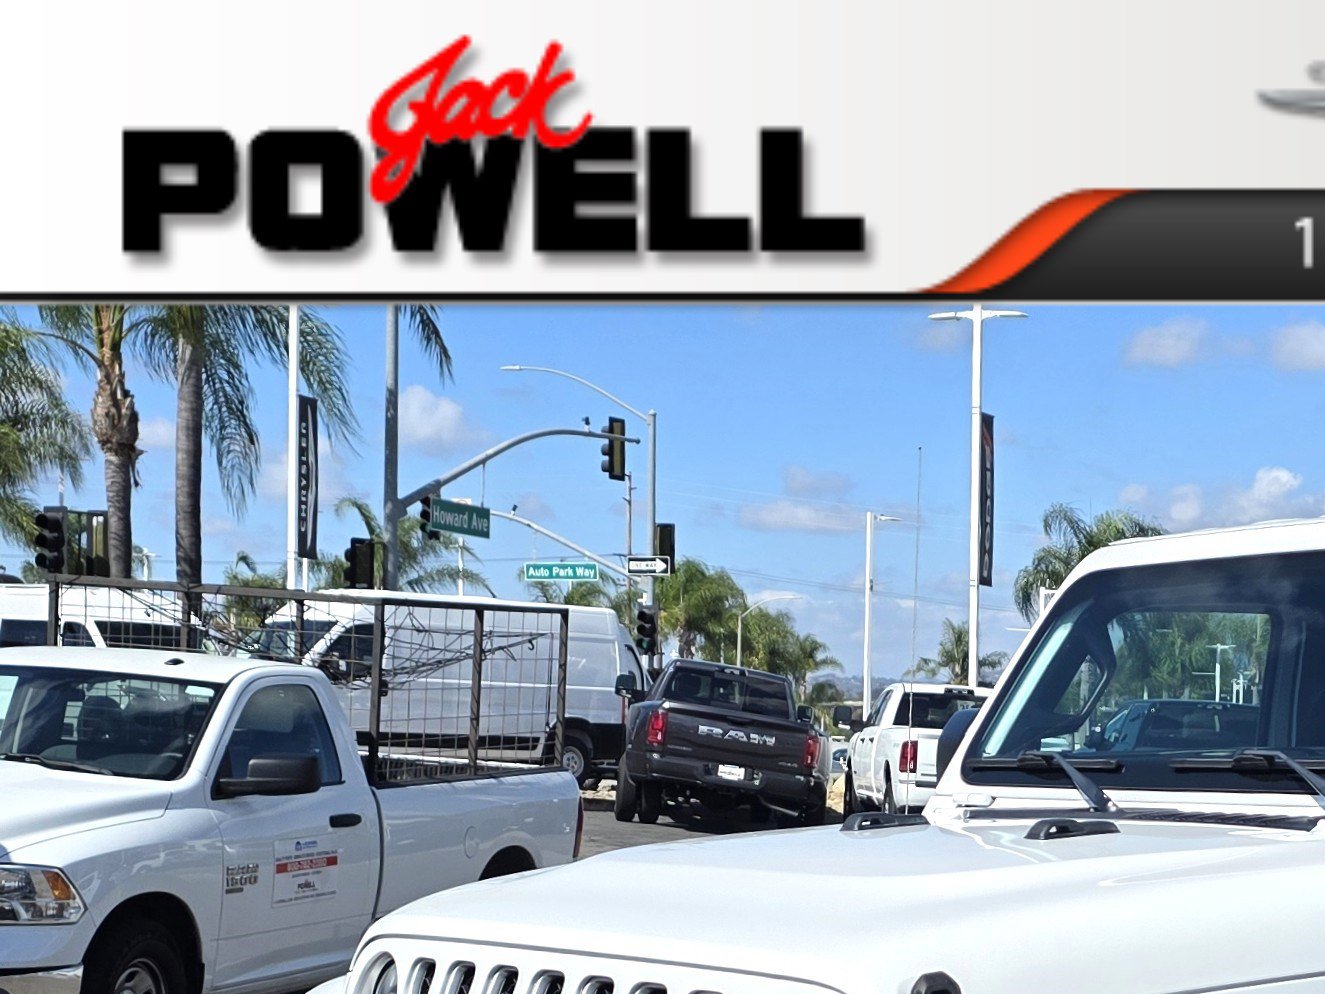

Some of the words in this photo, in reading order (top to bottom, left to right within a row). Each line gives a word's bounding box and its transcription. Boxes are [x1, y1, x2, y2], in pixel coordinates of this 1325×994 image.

[300, 422, 308, 532] CHRYSLER
[433, 505, 469, 529] Howard
[471, 512, 489, 531] Ave
[528, 566, 549, 577] Auto
[553, 566, 573, 577] Park
[576, 566, 594, 578] Way
[698, 725, 776, 747] RAM
